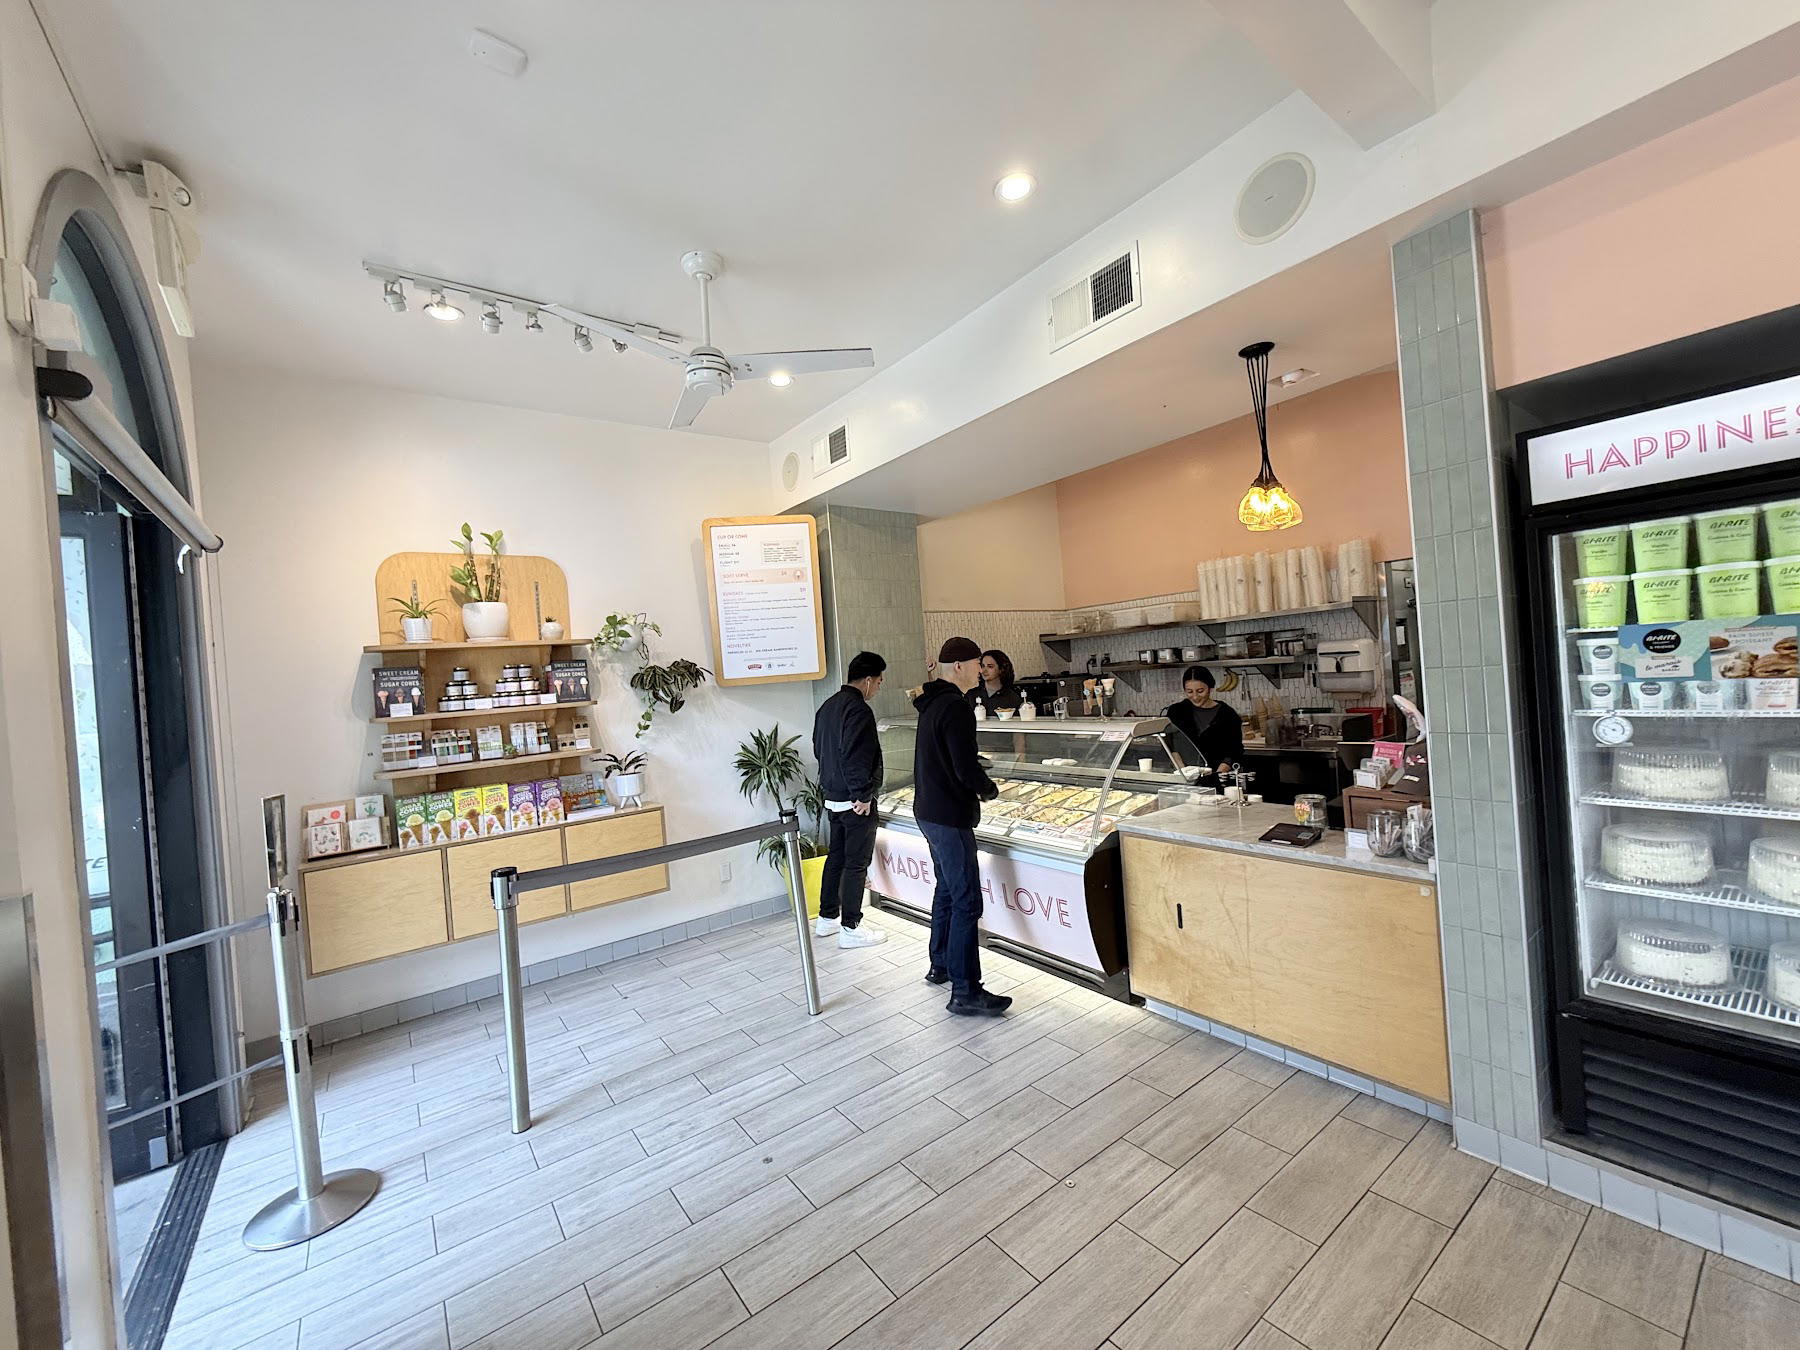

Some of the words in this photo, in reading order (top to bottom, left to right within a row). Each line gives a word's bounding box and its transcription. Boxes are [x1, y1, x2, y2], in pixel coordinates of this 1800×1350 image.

[1564, 403, 1800, 479] HAPPINE
[1641, 529, 1680, 539] BI-RITE
[1582, 535, 1618, 545] BI-RITE
[1709, 573, 1752, 584] BI-RITE
[1643, 579, 1681, 589] BI-RITE
[399, 806, 424, 816] CONES
[880, 851, 931, 885] MADE
[1002, 882, 1072, 928] LOVE
